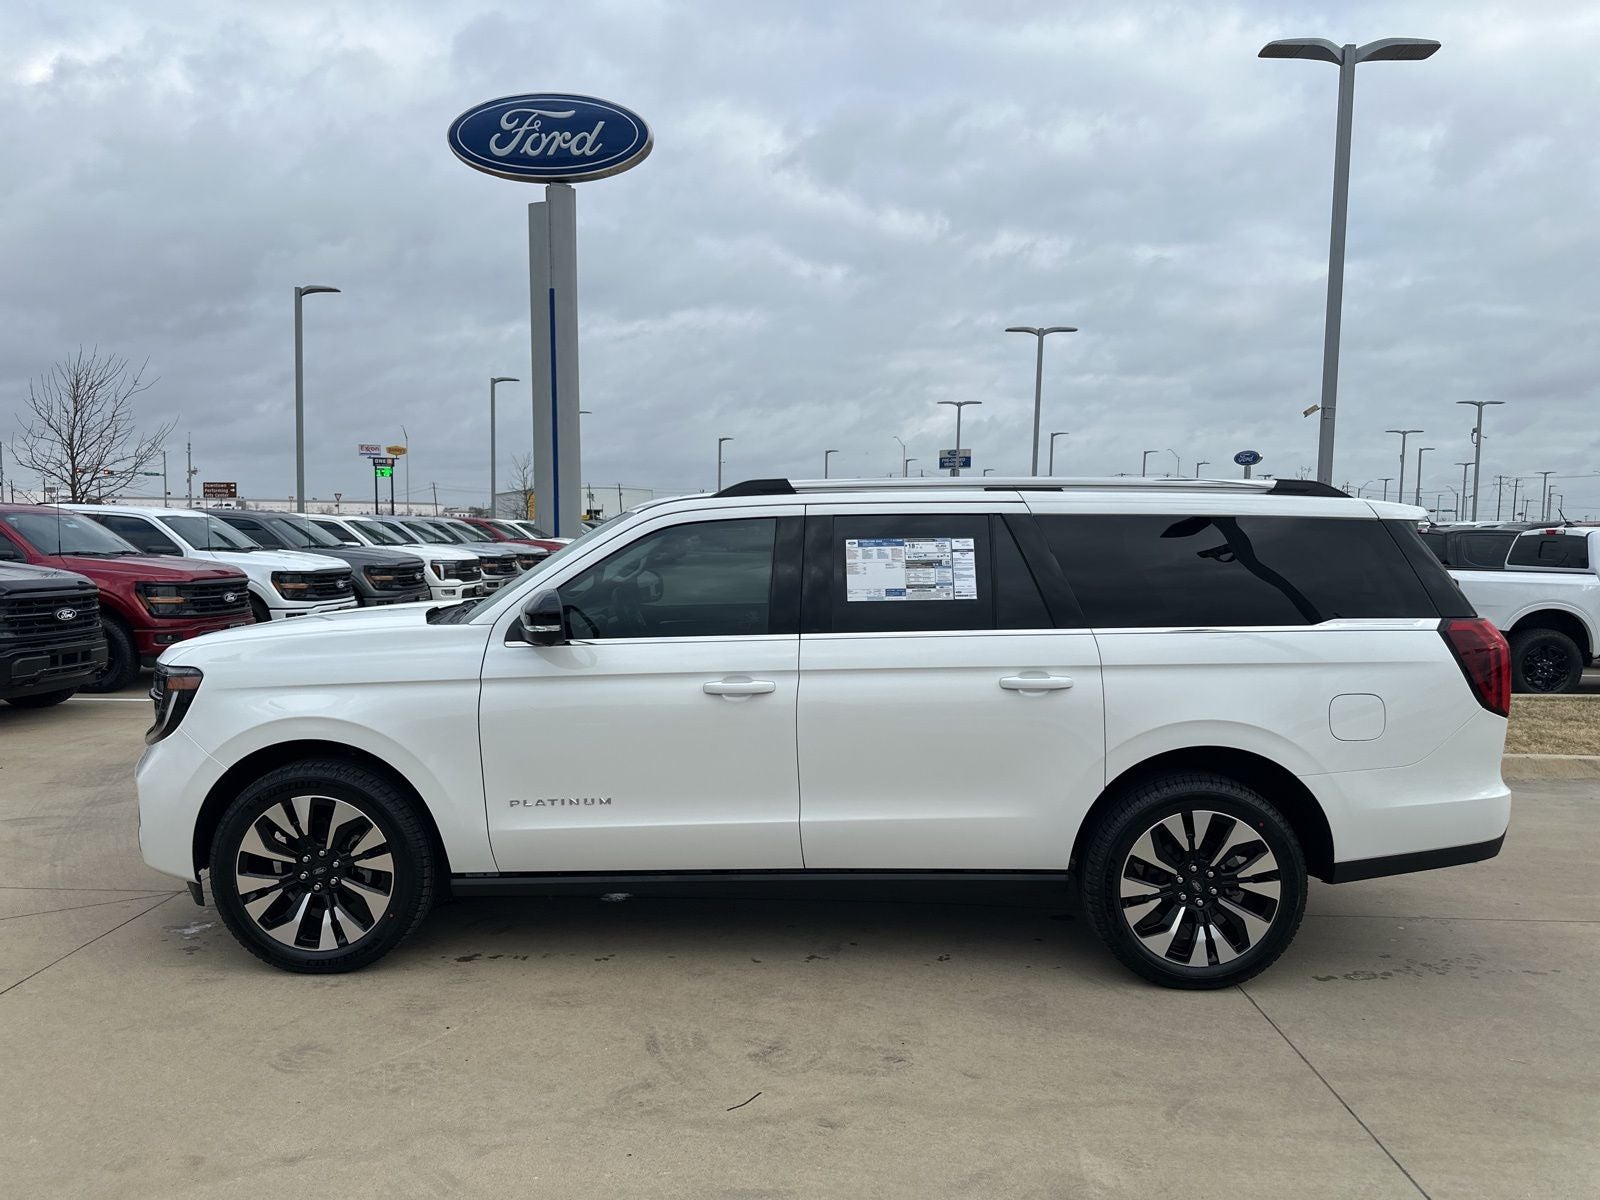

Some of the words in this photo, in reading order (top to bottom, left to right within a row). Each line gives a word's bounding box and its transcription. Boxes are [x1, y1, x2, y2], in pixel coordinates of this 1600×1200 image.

[489, 108, 606, 157] Ford
[360, 445, 380, 453] Exxon
[509, 797, 613, 808] PLATINUM
